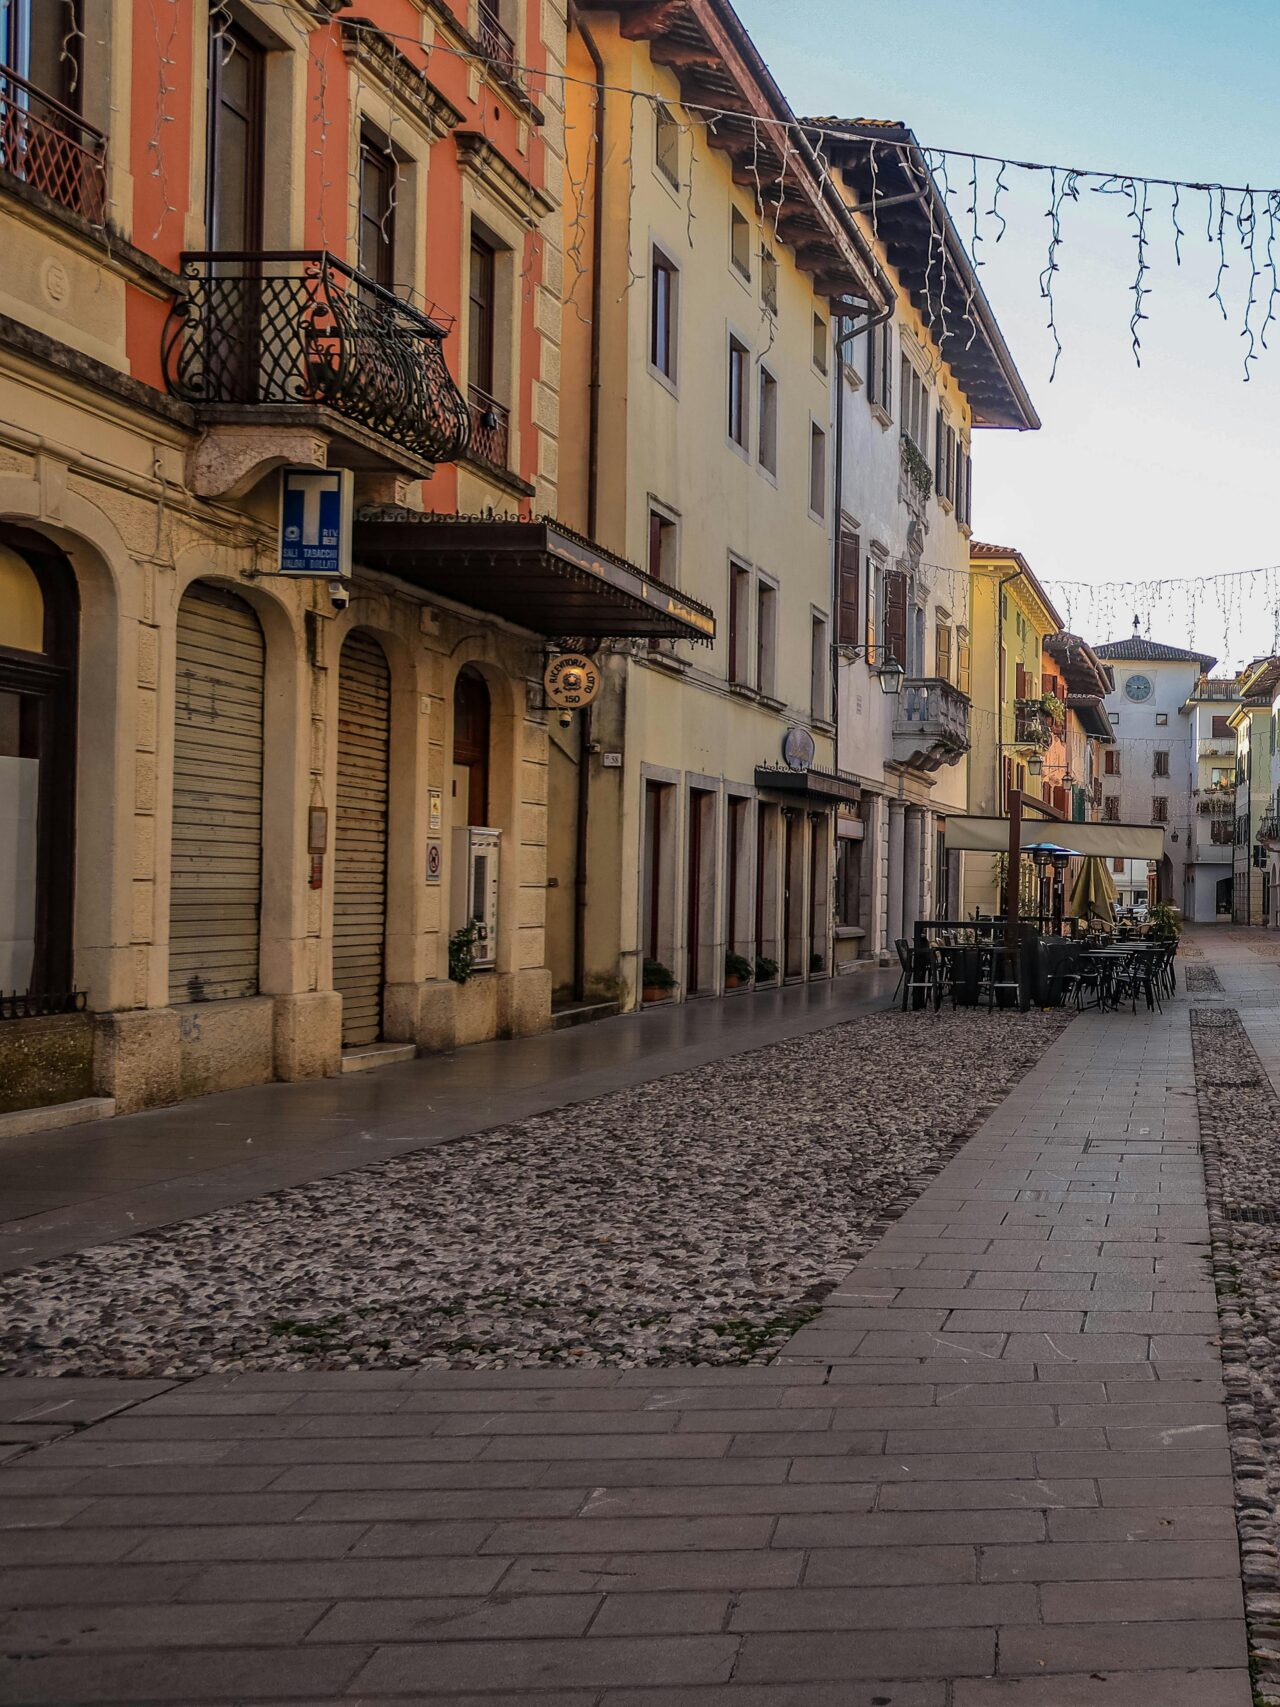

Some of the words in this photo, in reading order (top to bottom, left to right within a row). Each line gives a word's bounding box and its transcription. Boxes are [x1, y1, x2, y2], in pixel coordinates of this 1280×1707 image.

[287, 474, 338, 545] T
[283, 548, 298, 558] SALI
[303, 548, 338, 559] TABACCHI
[549, 658, 587, 684] RICEVITORIA
[583, 671, 596, 694] LOTTO
[564, 695, 581, 703] 150
